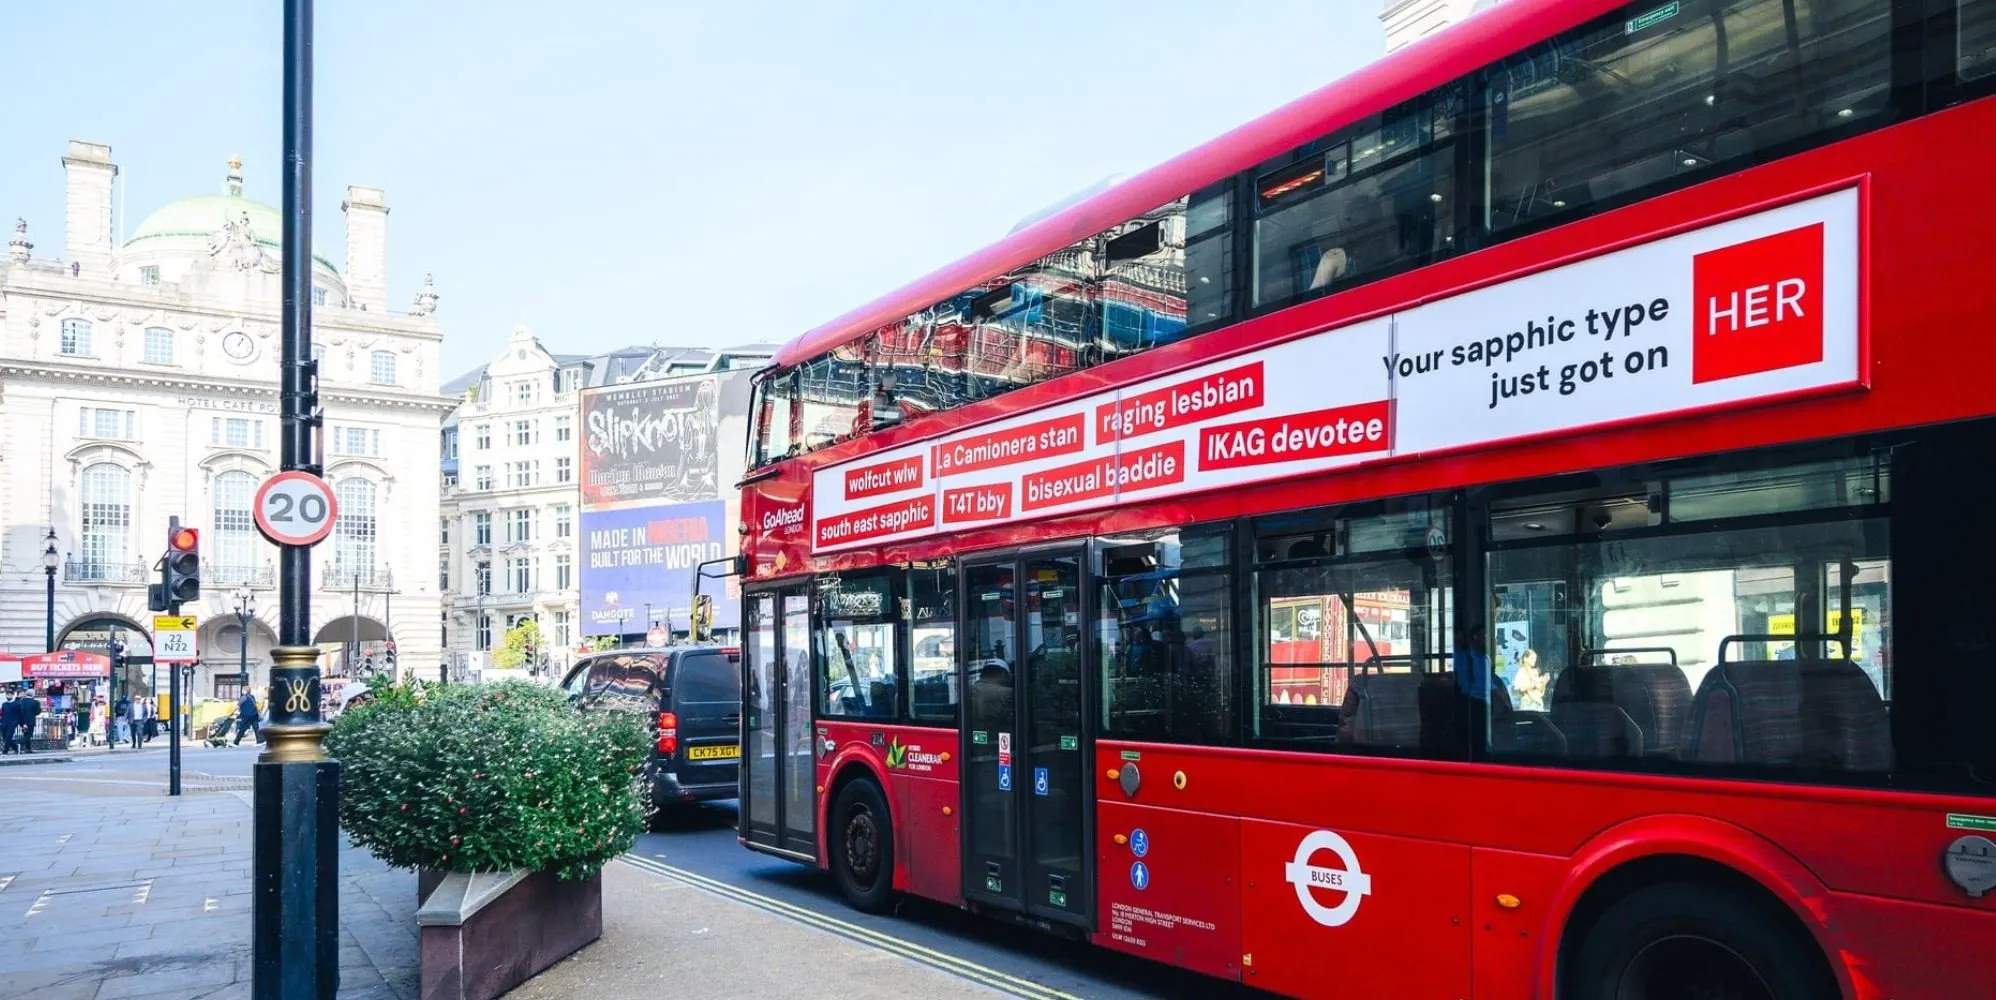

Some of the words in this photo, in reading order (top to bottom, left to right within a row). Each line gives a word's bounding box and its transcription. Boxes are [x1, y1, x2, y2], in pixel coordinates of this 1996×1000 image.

[1709, 277, 1806, 336] HER
[1382, 349, 1444, 381] Your
[1451, 316, 1575, 367] sapphic
[1585, 297, 1669, 341] type
[1489, 365, 1550, 409] just
[1559, 351, 1613, 395] got
[1624, 345, 1668, 374] on
[178, 397, 217, 408] HOTEL
[606, 391, 647, 401] WEMBLEY
[652, 385, 691, 396] STADIUM
[1103, 400, 1166, 434] raging
[1172, 377, 1254, 417] lesbian
[954, 437, 1036, 466] Camionera
[1040, 426, 1077, 449] stan
[1207, 427, 1265, 461] IKAG
[1271, 418, 1383, 453] devotee
[849, 468, 891, 493] wolfcut
[893, 463, 917, 484] wlw
[1029, 465, 1100, 503] bisexual
[1105, 452, 1176, 487] baddie
[269, 493, 326, 523] 20
[764, 502, 805, 529] GoAhead
[949, 492, 975, 515] T4T
[977, 489, 1006, 517] bby
[784, 523, 803, 535] LONDON
[821, 518, 851, 540] south
[854, 513, 878, 533] east
[880, 501, 928, 532] sapphic
[591, 528, 629, 549] MADE
[633, 527, 646, 545] IN
[591, 550, 621, 569] BUILT
[621, 549, 642, 566] FOR
[644, 547, 664, 565] THE
[591, 607, 635, 621] DANGOTE
[164, 643, 187, 651] N22
[169, 634, 182, 642] 22
[31, 663, 50, 671] BUY
[50, 663, 80, 671] TICKETS
[693, 747, 718, 757] CK75
[1311, 871, 1343, 886] BUSES
